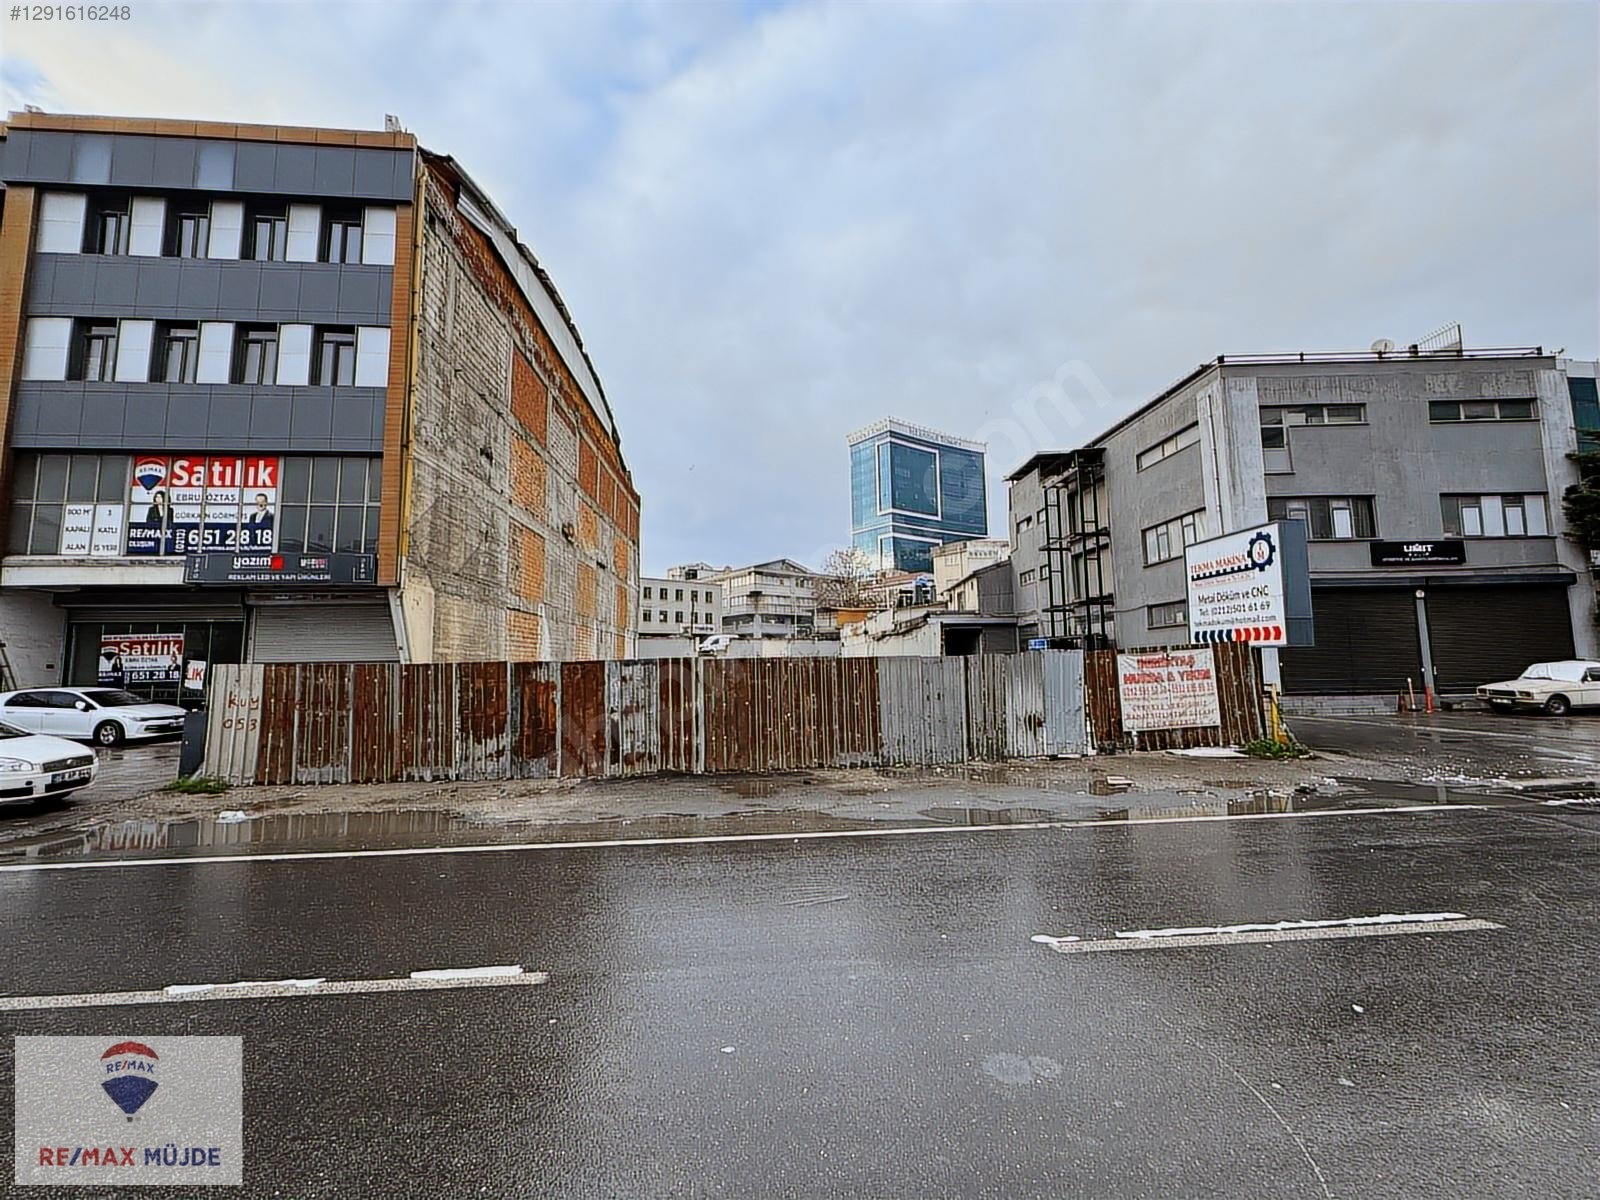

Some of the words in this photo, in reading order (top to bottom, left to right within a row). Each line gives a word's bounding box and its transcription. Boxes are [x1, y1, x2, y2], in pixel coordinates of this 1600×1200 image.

[172, 460, 273, 487] Satılık
[226, 529, 250, 545] 28
[255, 529, 272, 545] 18
[1251, 585, 1269, 598] CNC
[120, 641, 180, 656] Satılık
